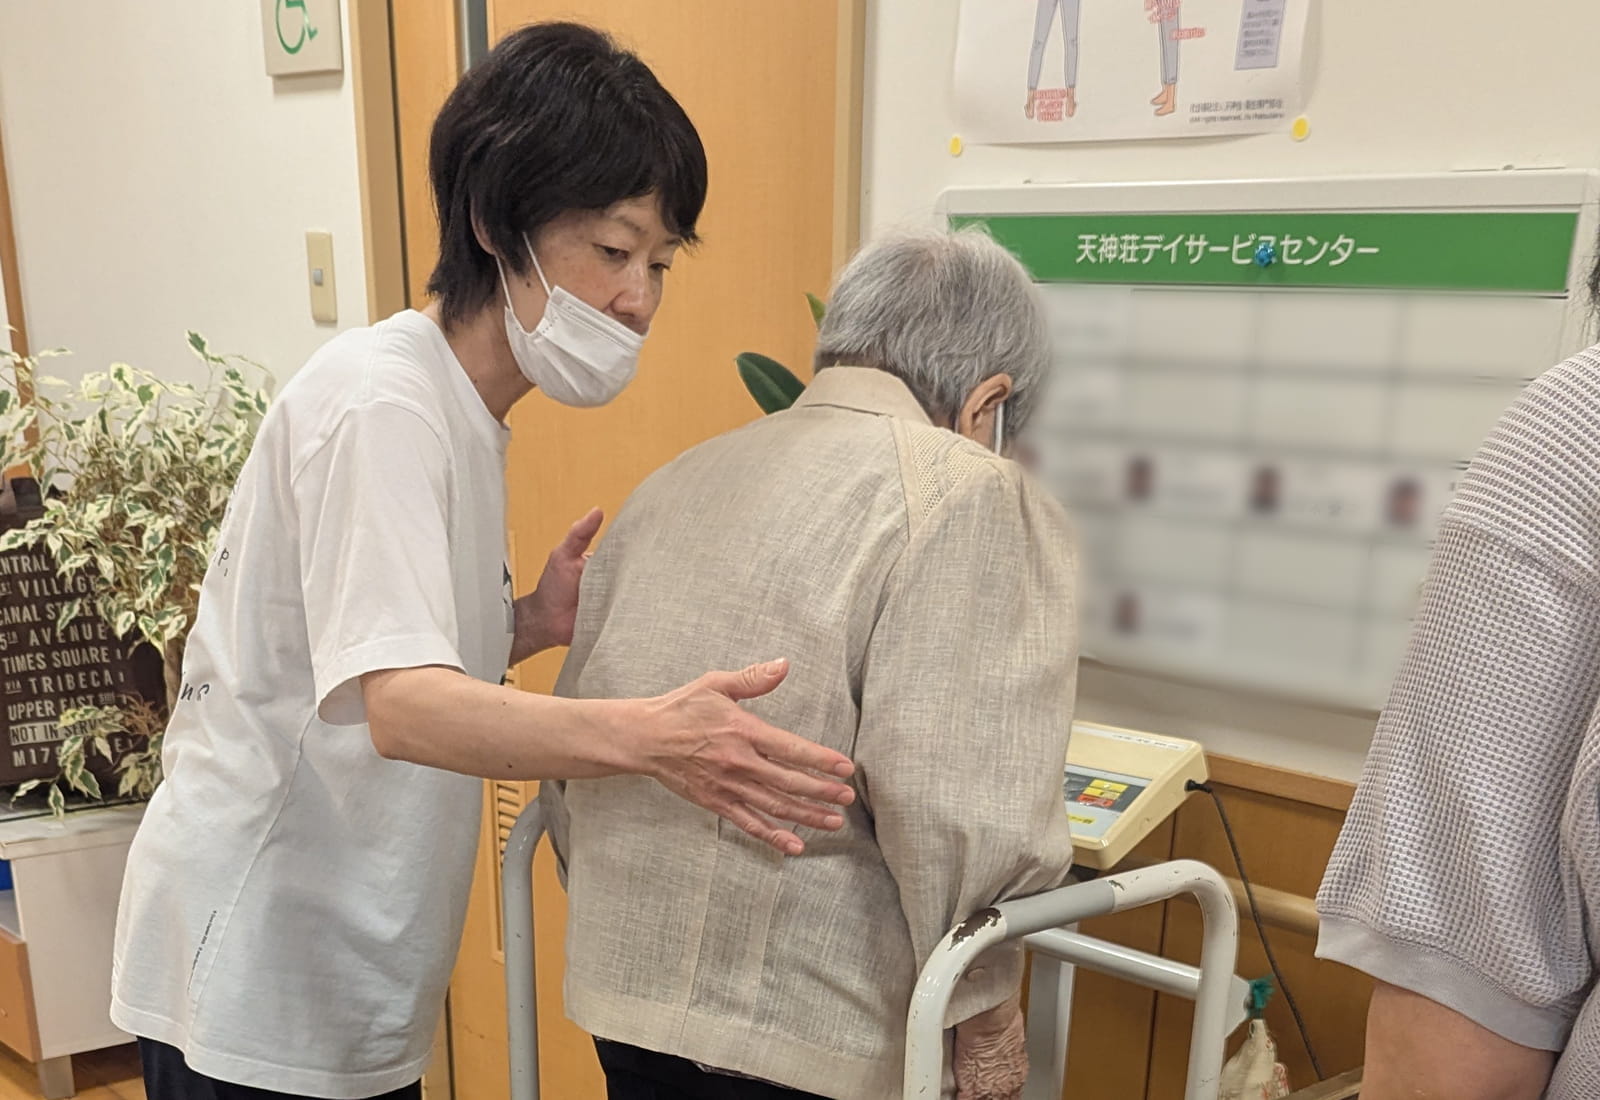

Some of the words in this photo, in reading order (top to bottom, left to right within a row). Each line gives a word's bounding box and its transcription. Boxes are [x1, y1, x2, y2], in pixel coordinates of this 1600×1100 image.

[0, 554, 50, 576] NTRAL
[29, 622, 107, 647] AVENUE
[2, 653, 47, 675] TIMES
[51, 646, 110, 668] SQUARE
[28, 669, 113, 694] TRIBECA
[8, 699, 56, 720] UPPER
[11, 725, 38, 745] NOT
[43, 722, 59, 740] IN
